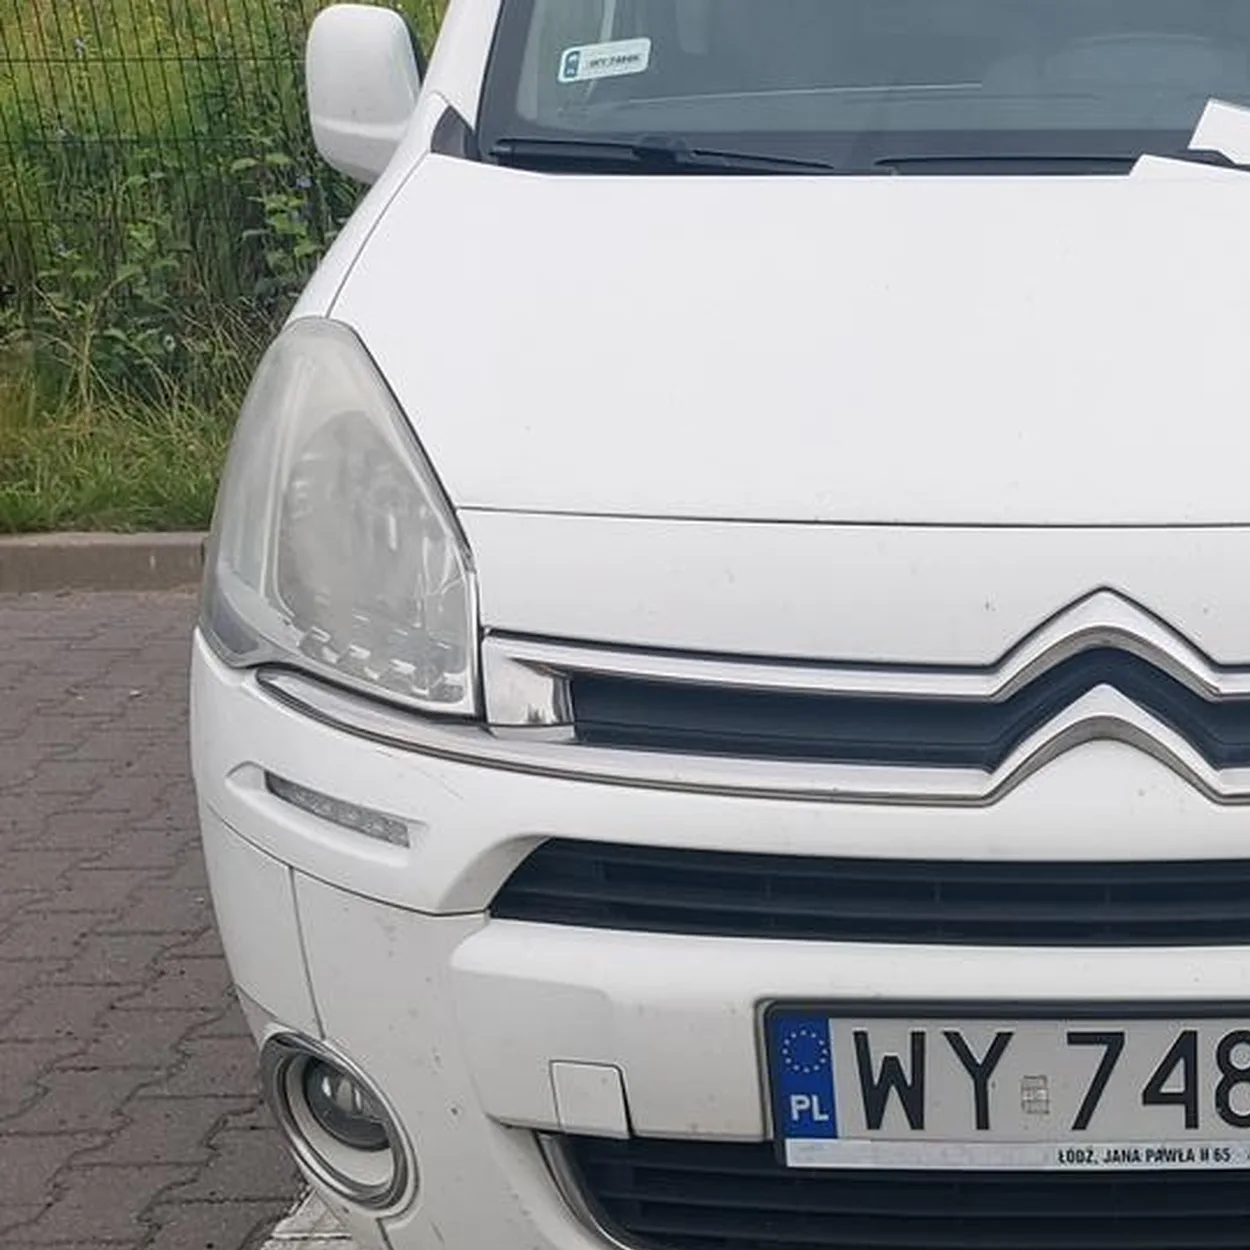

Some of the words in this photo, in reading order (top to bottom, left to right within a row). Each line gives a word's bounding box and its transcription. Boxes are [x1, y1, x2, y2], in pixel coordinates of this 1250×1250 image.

[853, 1030, 1015, 1130] WY
[790, 1094, 829, 1121] PL
[1103, 1148, 1142, 1164] JANA
[1145, 1147, 1195, 1164] PAWŁA
[1214, 1147, 1232, 1163] 65
